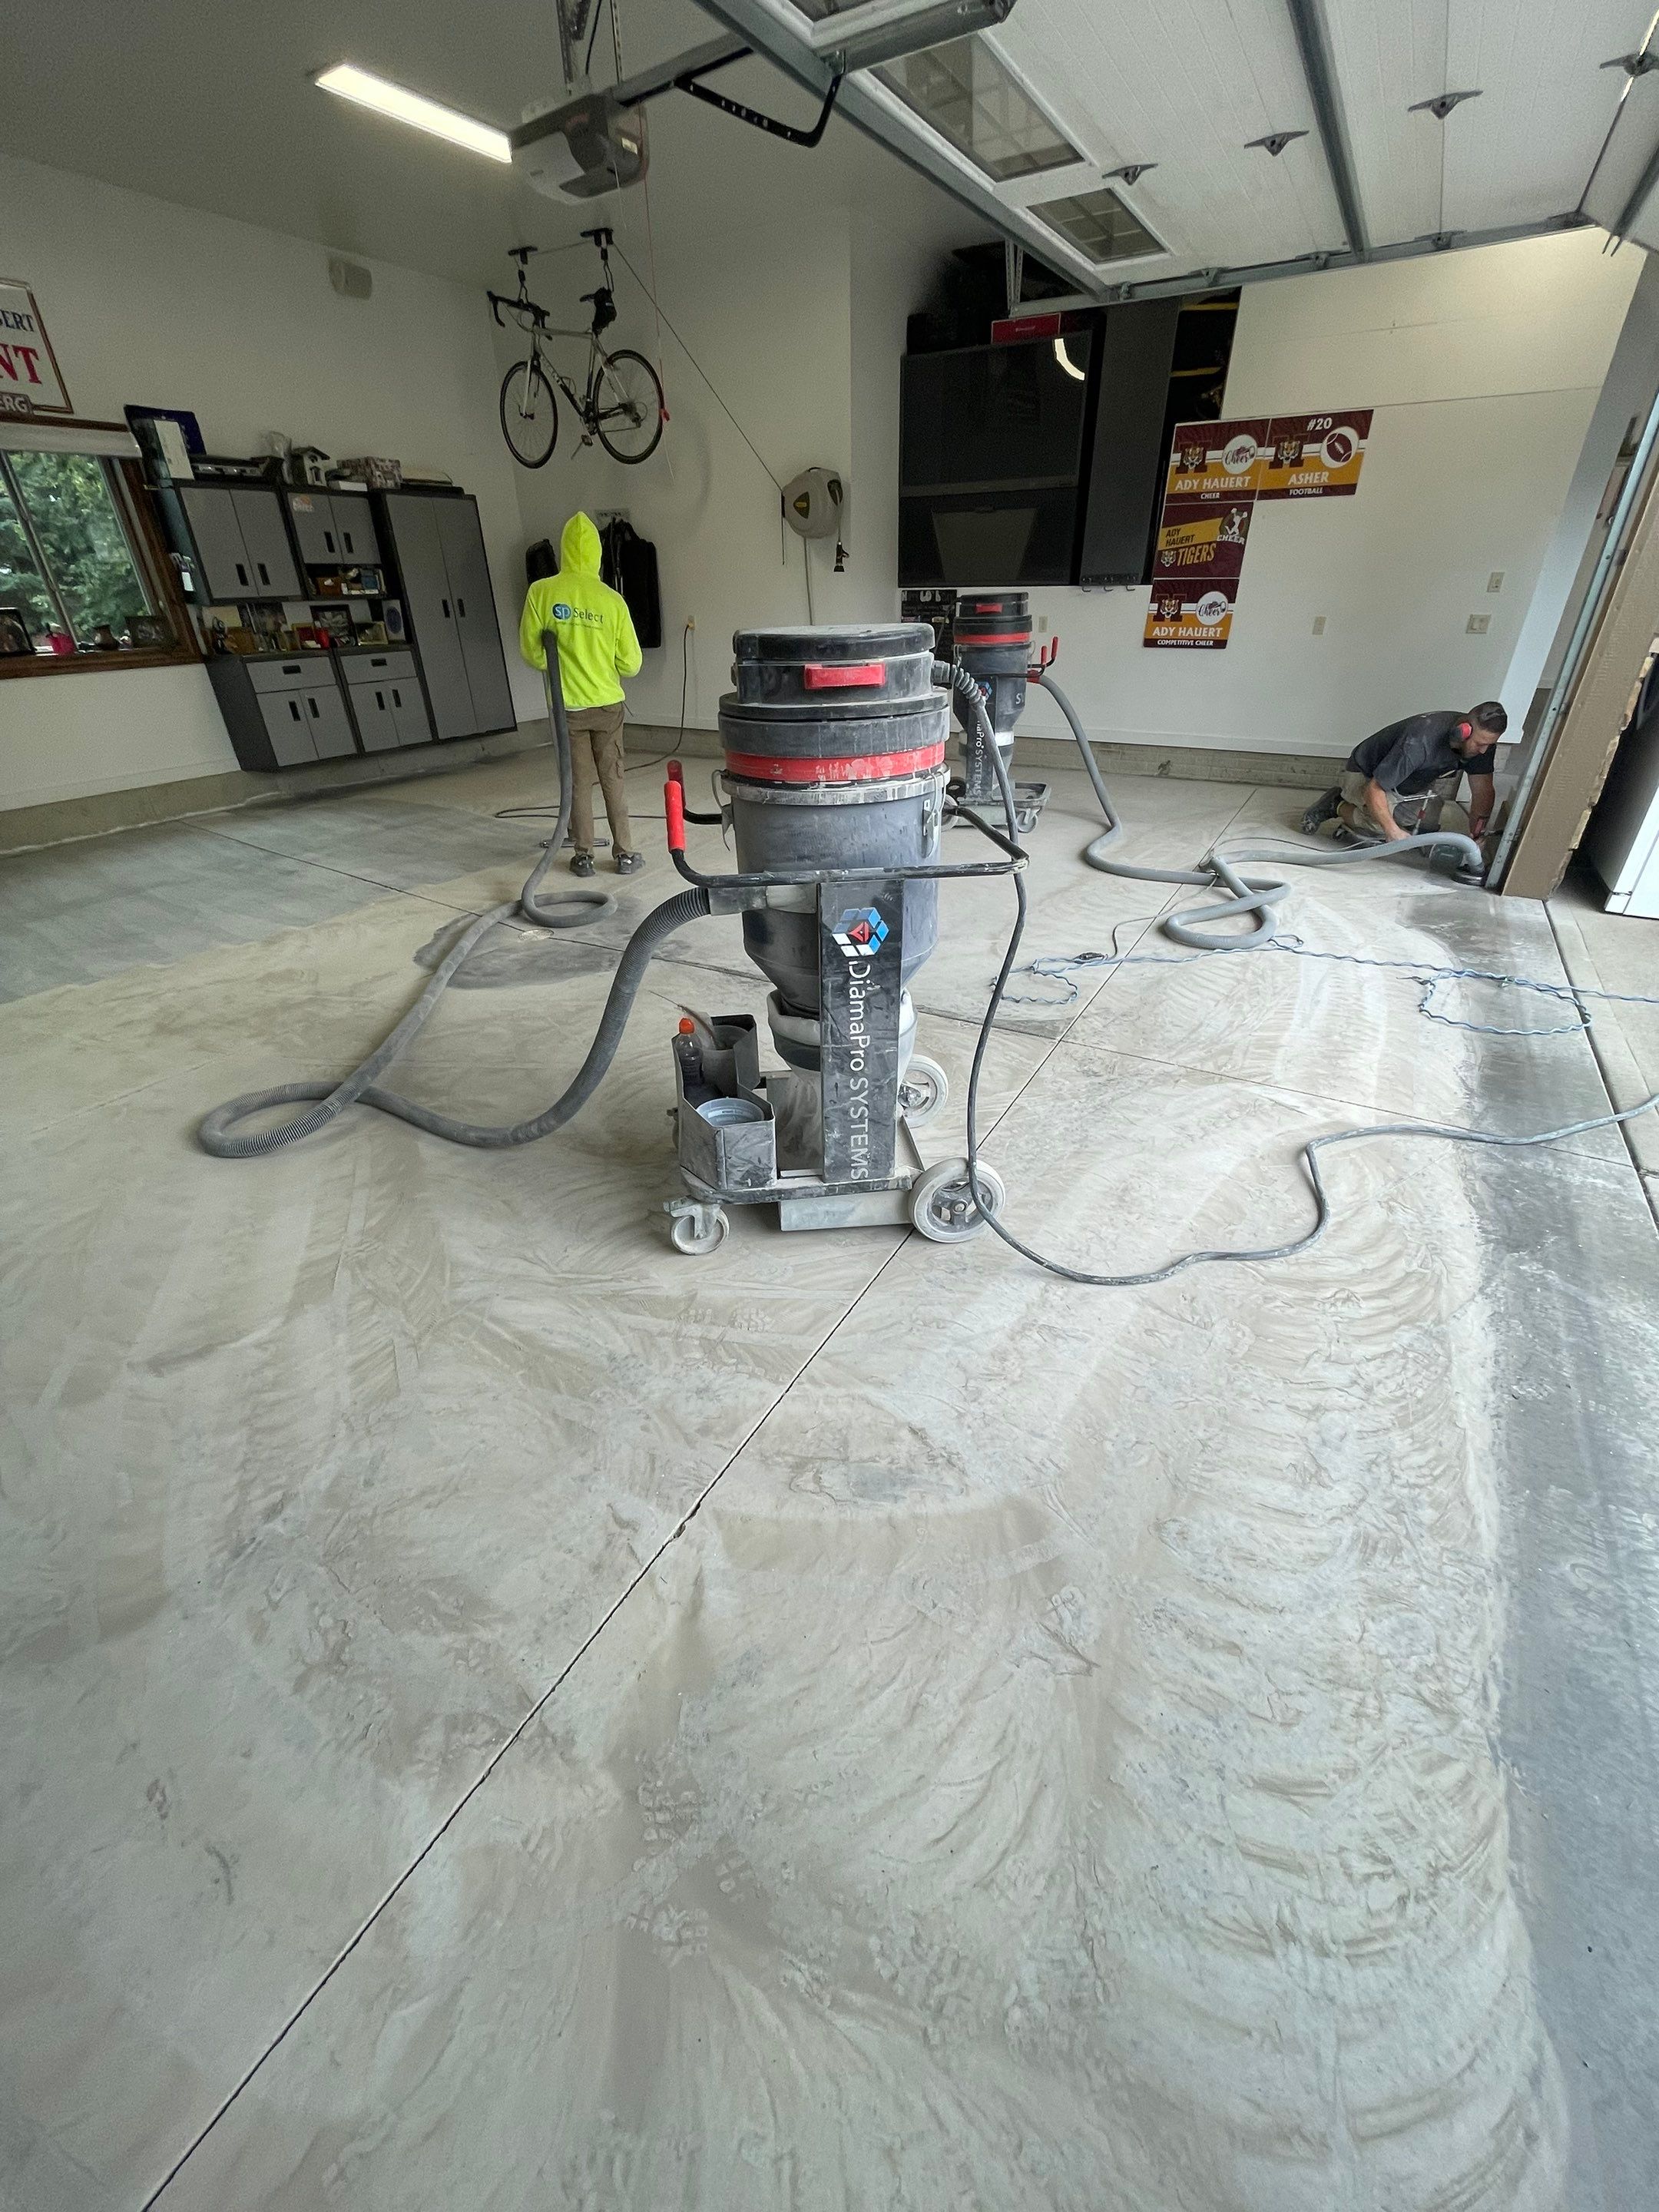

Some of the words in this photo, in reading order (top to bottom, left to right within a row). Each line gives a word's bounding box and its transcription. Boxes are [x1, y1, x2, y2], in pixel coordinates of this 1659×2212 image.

[0, 309, 35, 332] ERT
[1306, 417, 1333, 431] #20
[1175, 478, 1200, 491] ADY
[1202, 476, 1251, 489] HAUERT
[1288, 472, 1330, 485] ASHER
[1290, 487, 1323, 495] FOOTBALL
[1166, 528, 1181, 538] ADY
[1217, 535, 1245, 545] CHEER
[1166, 535, 1195, 547] HAUERT
[1177, 543, 1217, 567] TIGERS
[573, 607, 604, 624] Select
[1153, 626, 1176, 637] ADY
[1178, 627, 1223, 637] HAUERT
[973, 750, 983, 796] SYSTEMS
[848, 960, 871, 1071] DiamaPro
[849, 1077, 869, 1181] SYSTEMS
